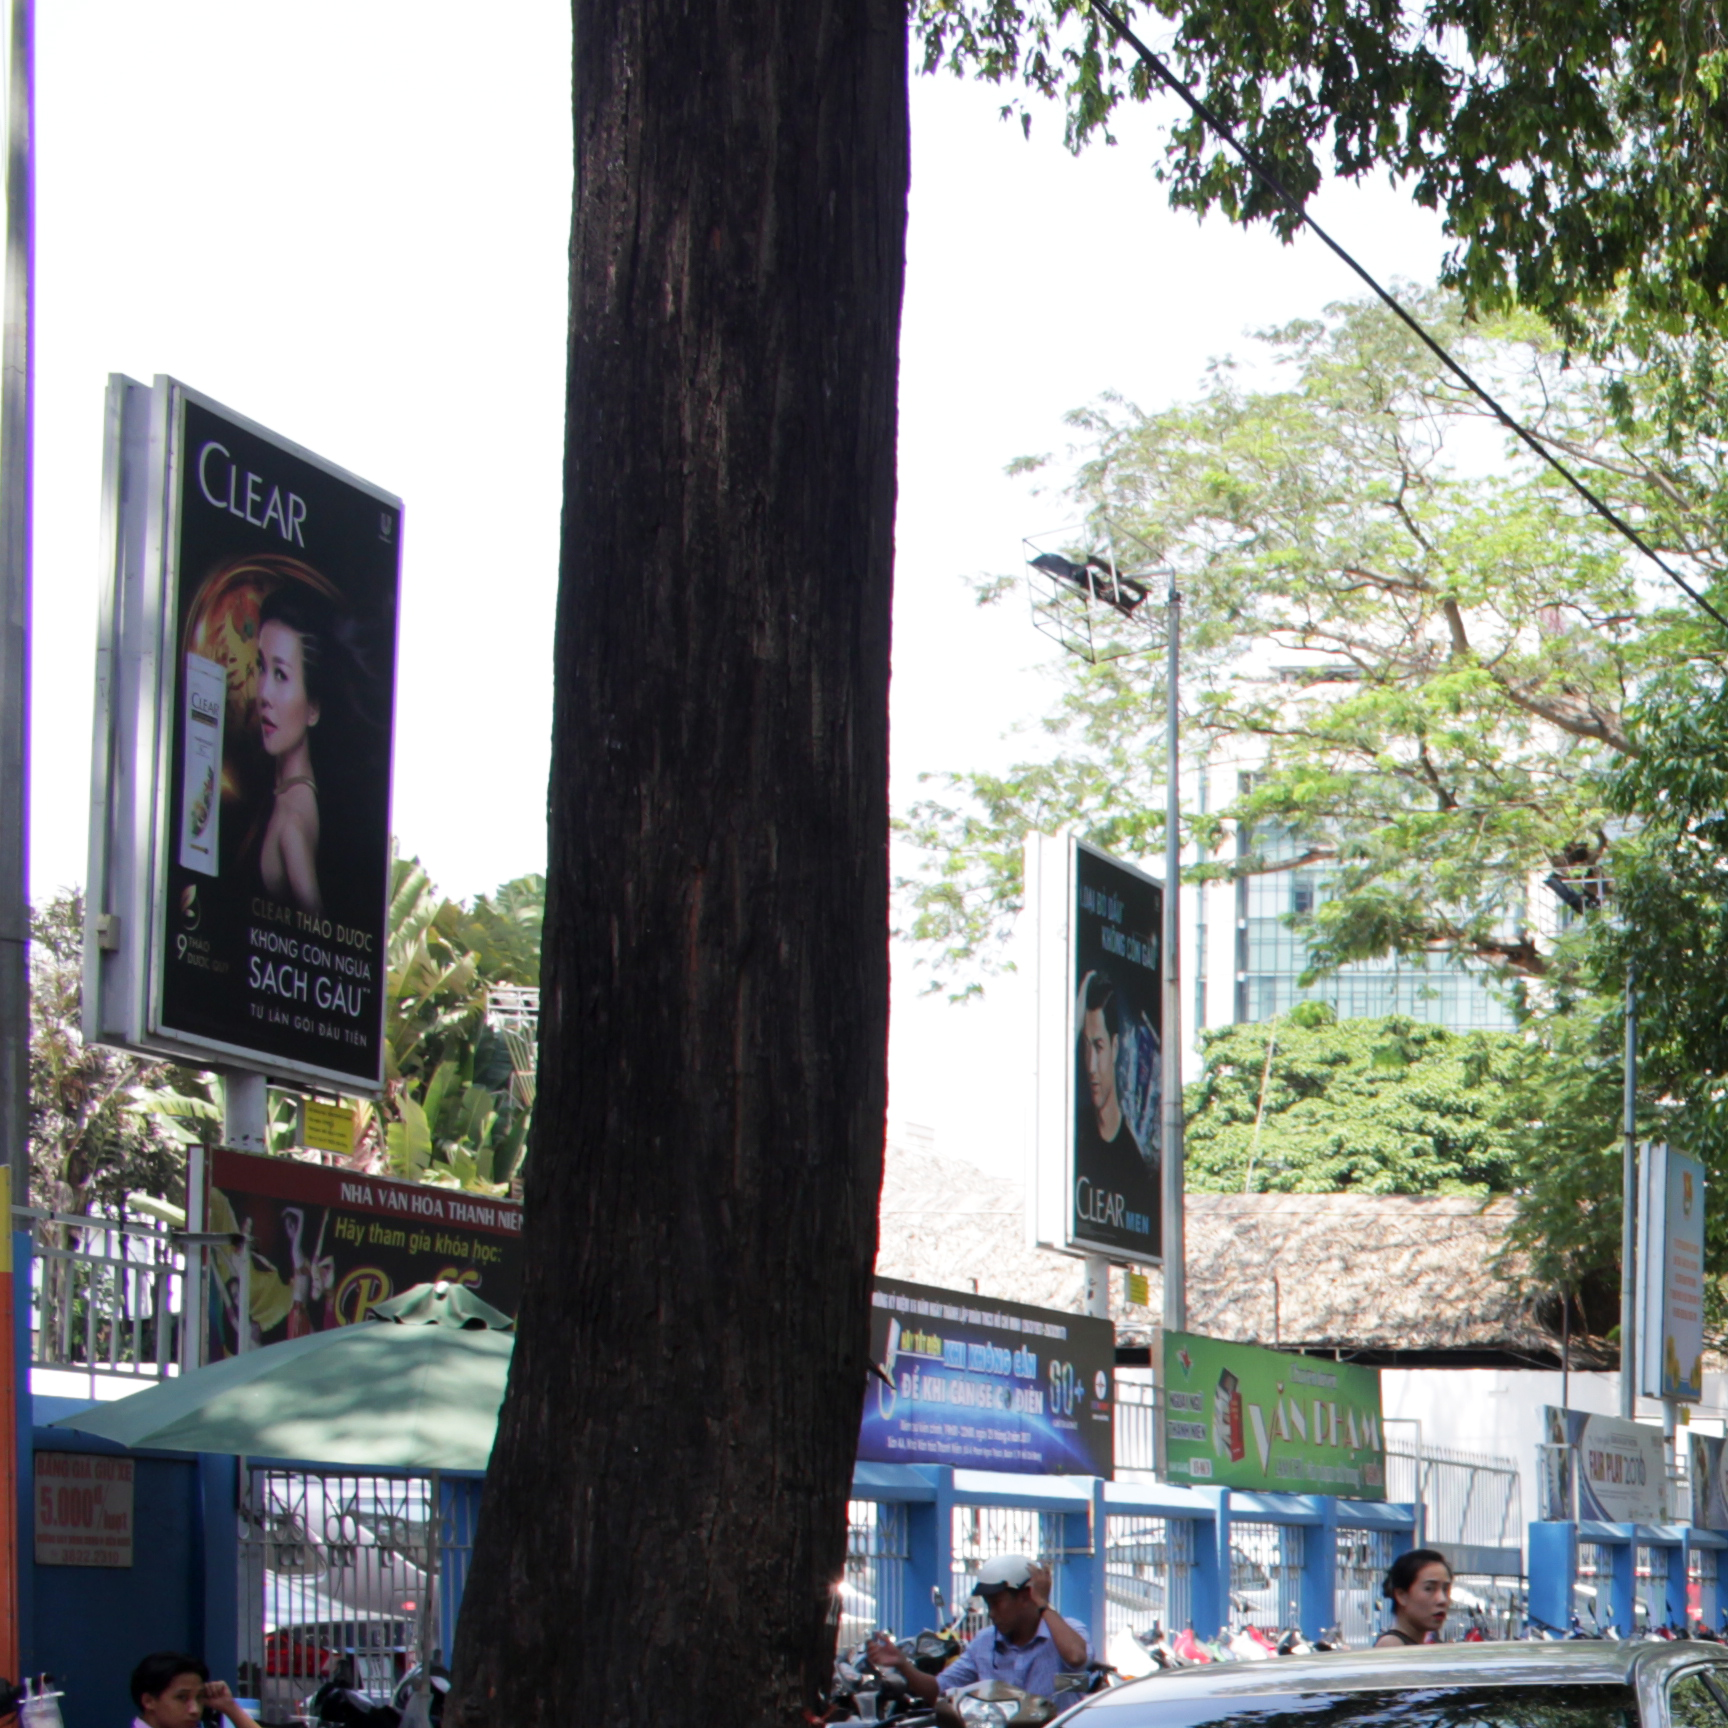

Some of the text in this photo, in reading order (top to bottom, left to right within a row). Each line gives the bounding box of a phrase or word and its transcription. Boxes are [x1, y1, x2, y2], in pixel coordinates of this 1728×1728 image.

[198, 441, 307, 548] CLEAR
[252, 898, 291, 926] CLEAR
[176, 933, 187, 960] 9
[250, 928, 299, 958] KHÔNG
[249, 955, 308, 1002] SẠCH
[341, 1182, 373, 1206] NHÀ
[377, 1188, 408, 1212] VĂN
[411, 1193, 444, 1218] HÓA
[448, 1201, 495, 1226] THANH
[1076, 1176, 1149, 1235] CLEAR MEN
[335, 1216, 366, 1246] Hãy
[369, 1222, 405, 1248] tham
[409, 1229, 431, 1255] gia
[434, 1233, 469, 1258] khóa
[922, 1375, 946, 1403] KHI
[117, 1463, 133, 1481] XE
